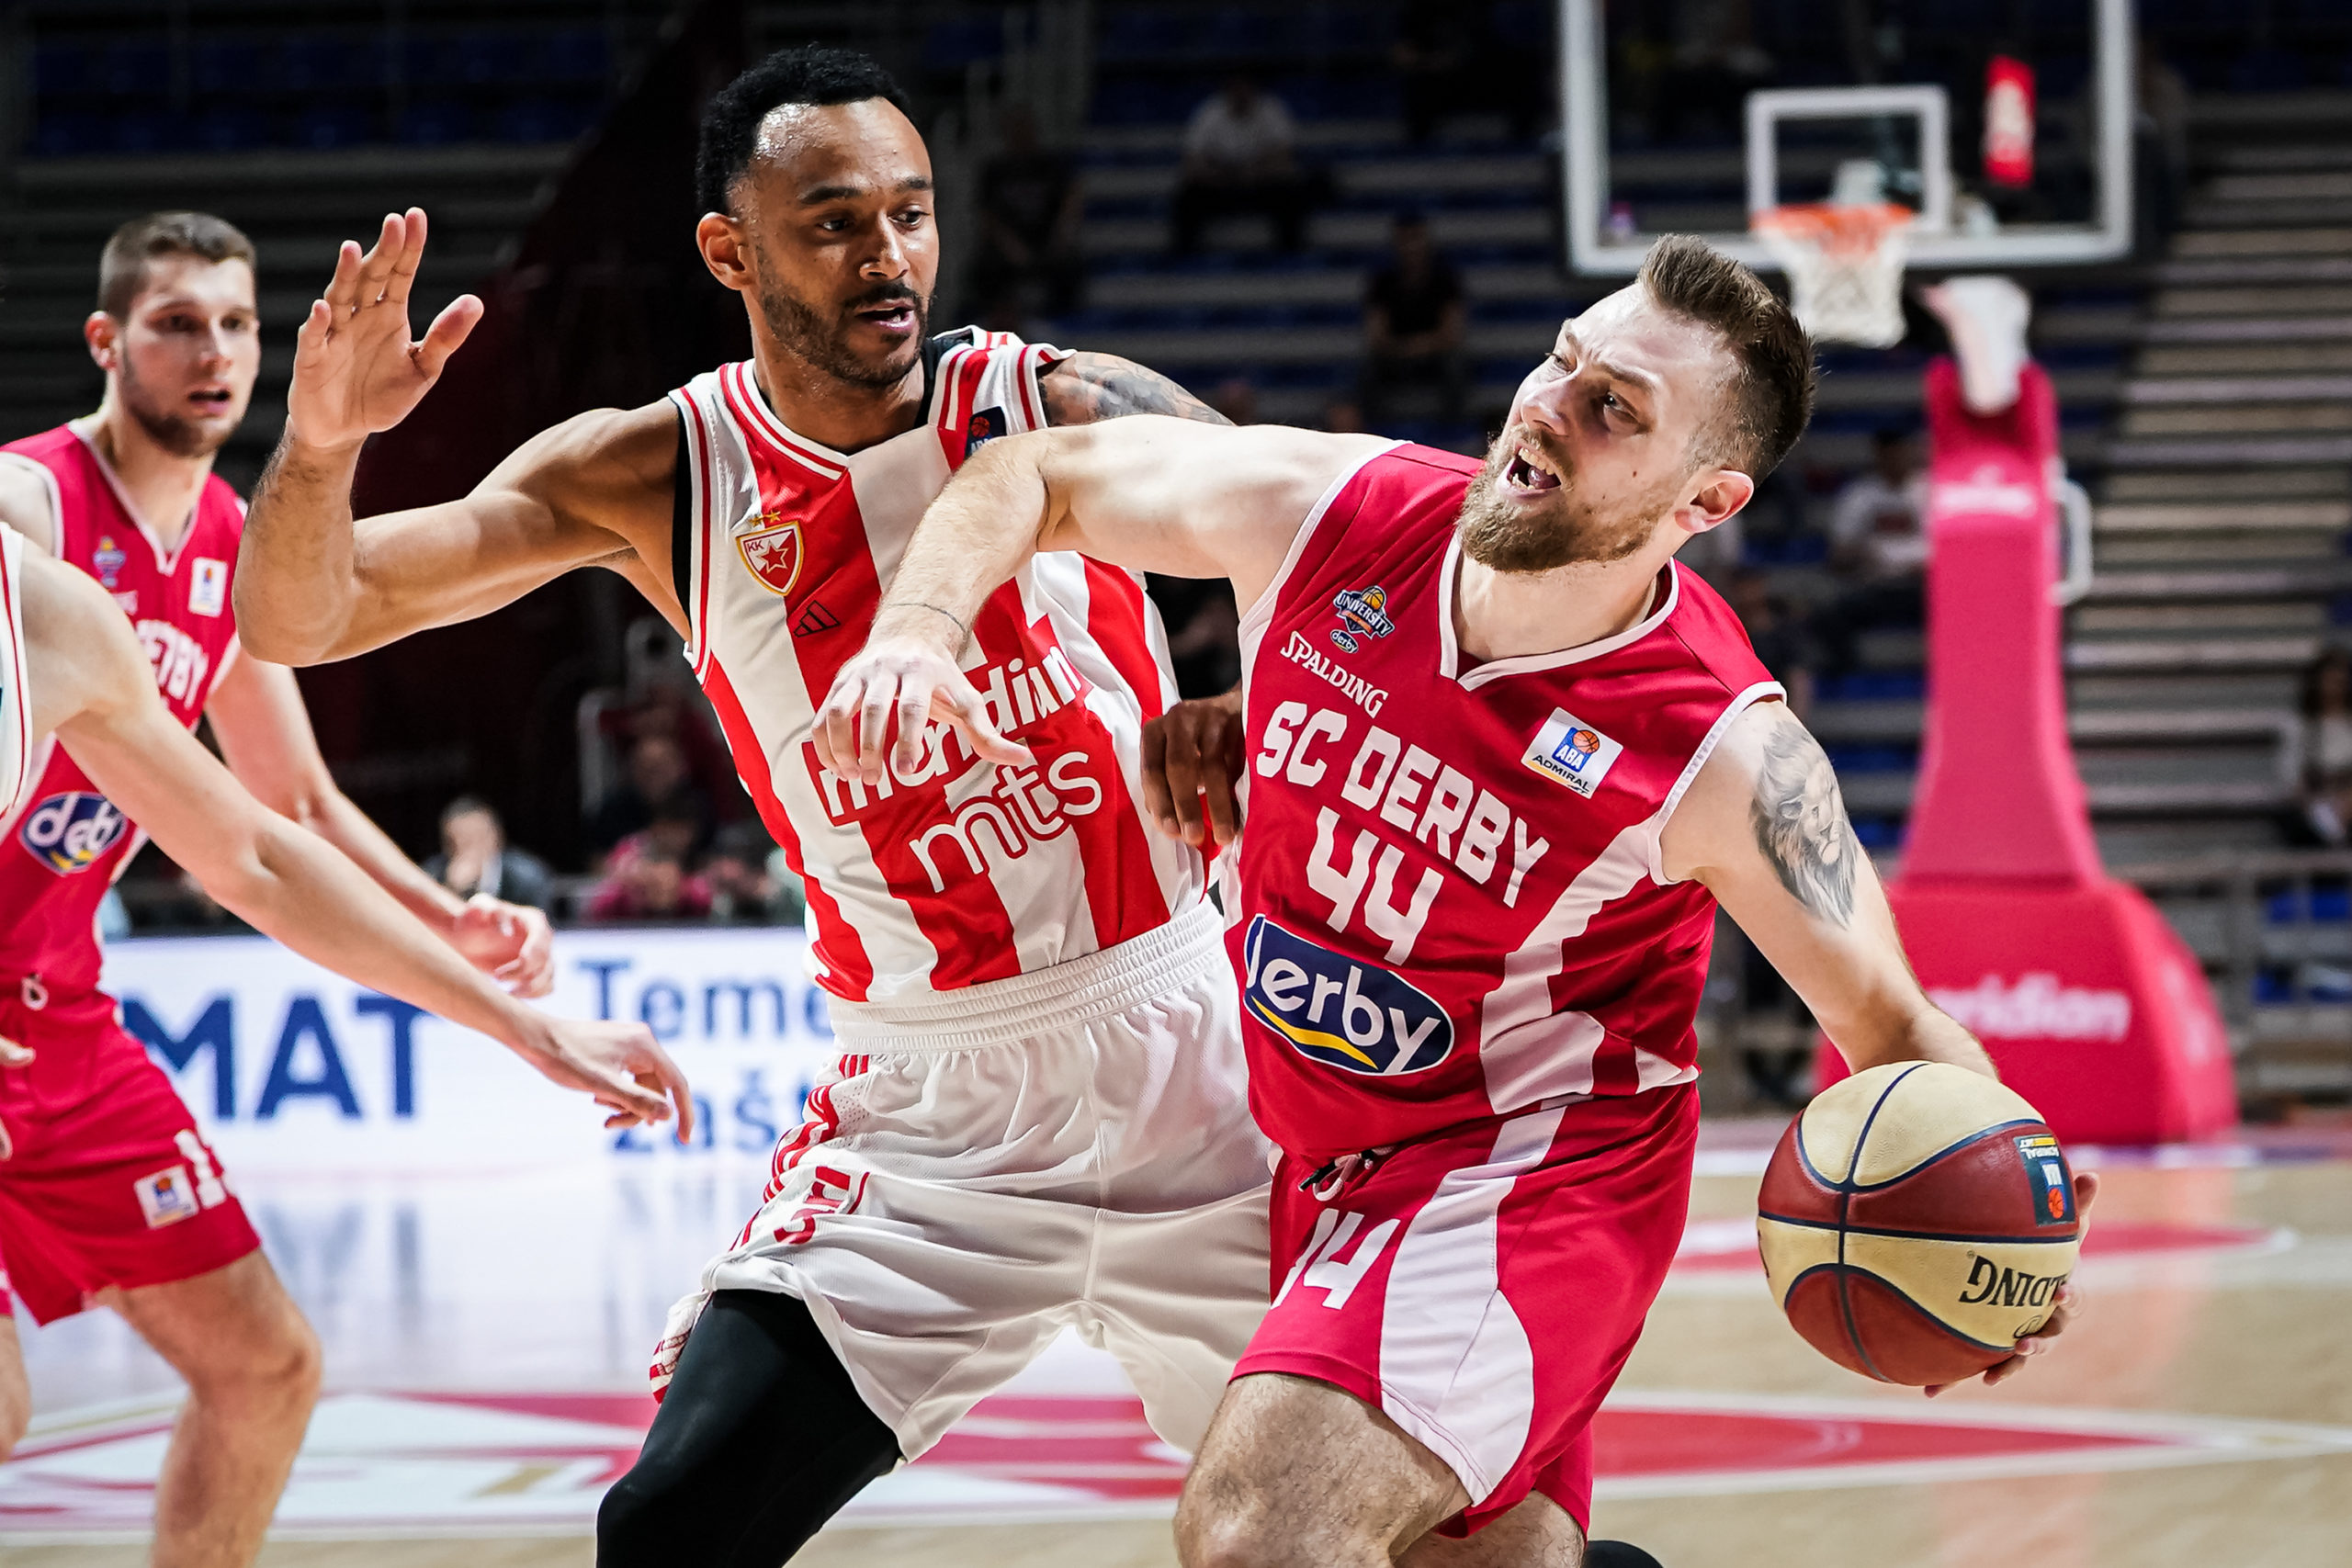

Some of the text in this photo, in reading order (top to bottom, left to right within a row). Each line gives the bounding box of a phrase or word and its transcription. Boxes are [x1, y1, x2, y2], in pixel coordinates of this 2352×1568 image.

[747, 539, 765, 552] KK
[1336, 593, 1392, 635] UNIVERSITY
[1330, 630, 1359, 653] derby
[1280, 631, 1389, 719] SPALDING
[1532, 754, 1590, 793] ADMIRAL
[1555, 744, 1585, 771] ABA
[908, 750, 1102, 894] mts
[1256, 700, 1551, 909] SC DERBY
[1306, 806, 1445, 966] 44
